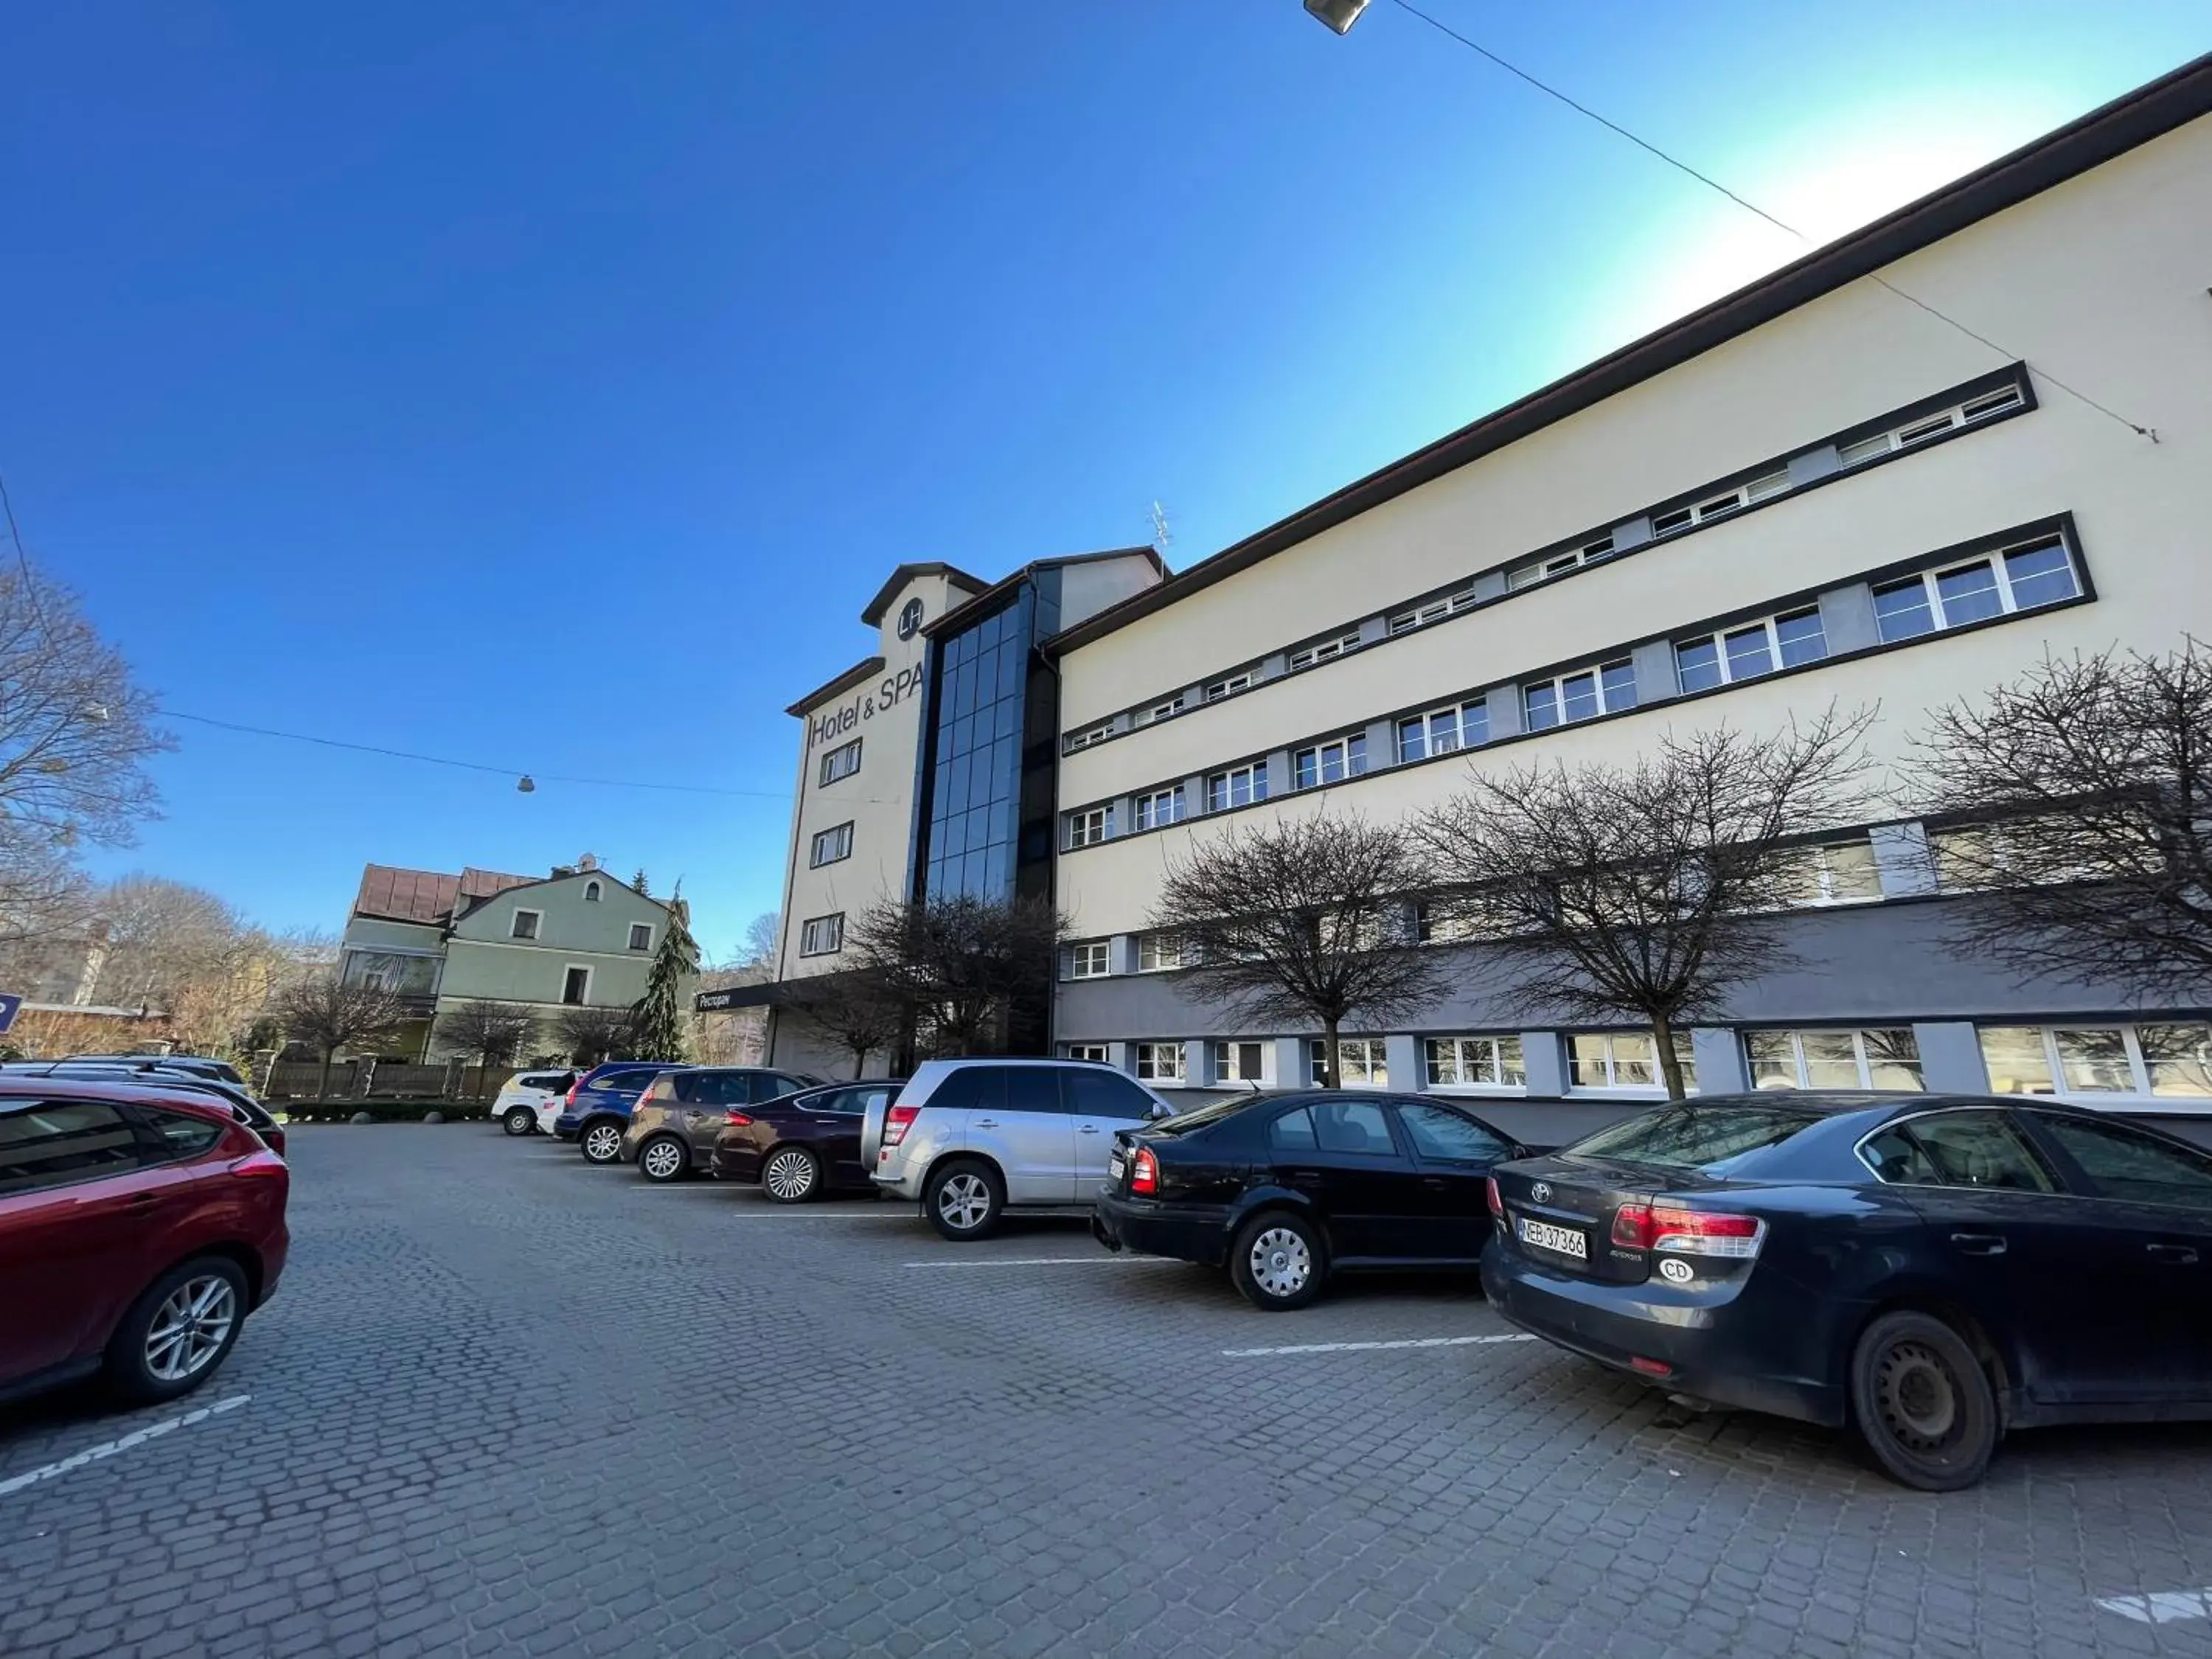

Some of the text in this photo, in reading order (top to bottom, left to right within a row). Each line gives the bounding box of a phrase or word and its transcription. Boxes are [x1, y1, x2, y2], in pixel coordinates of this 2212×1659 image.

[899, 604, 922, 635] LH
[810, 660, 923, 748] Hotel & SPA
[1546, 1226, 1585, 1254] 37366
[1665, 1262, 1688, 1278] CD
